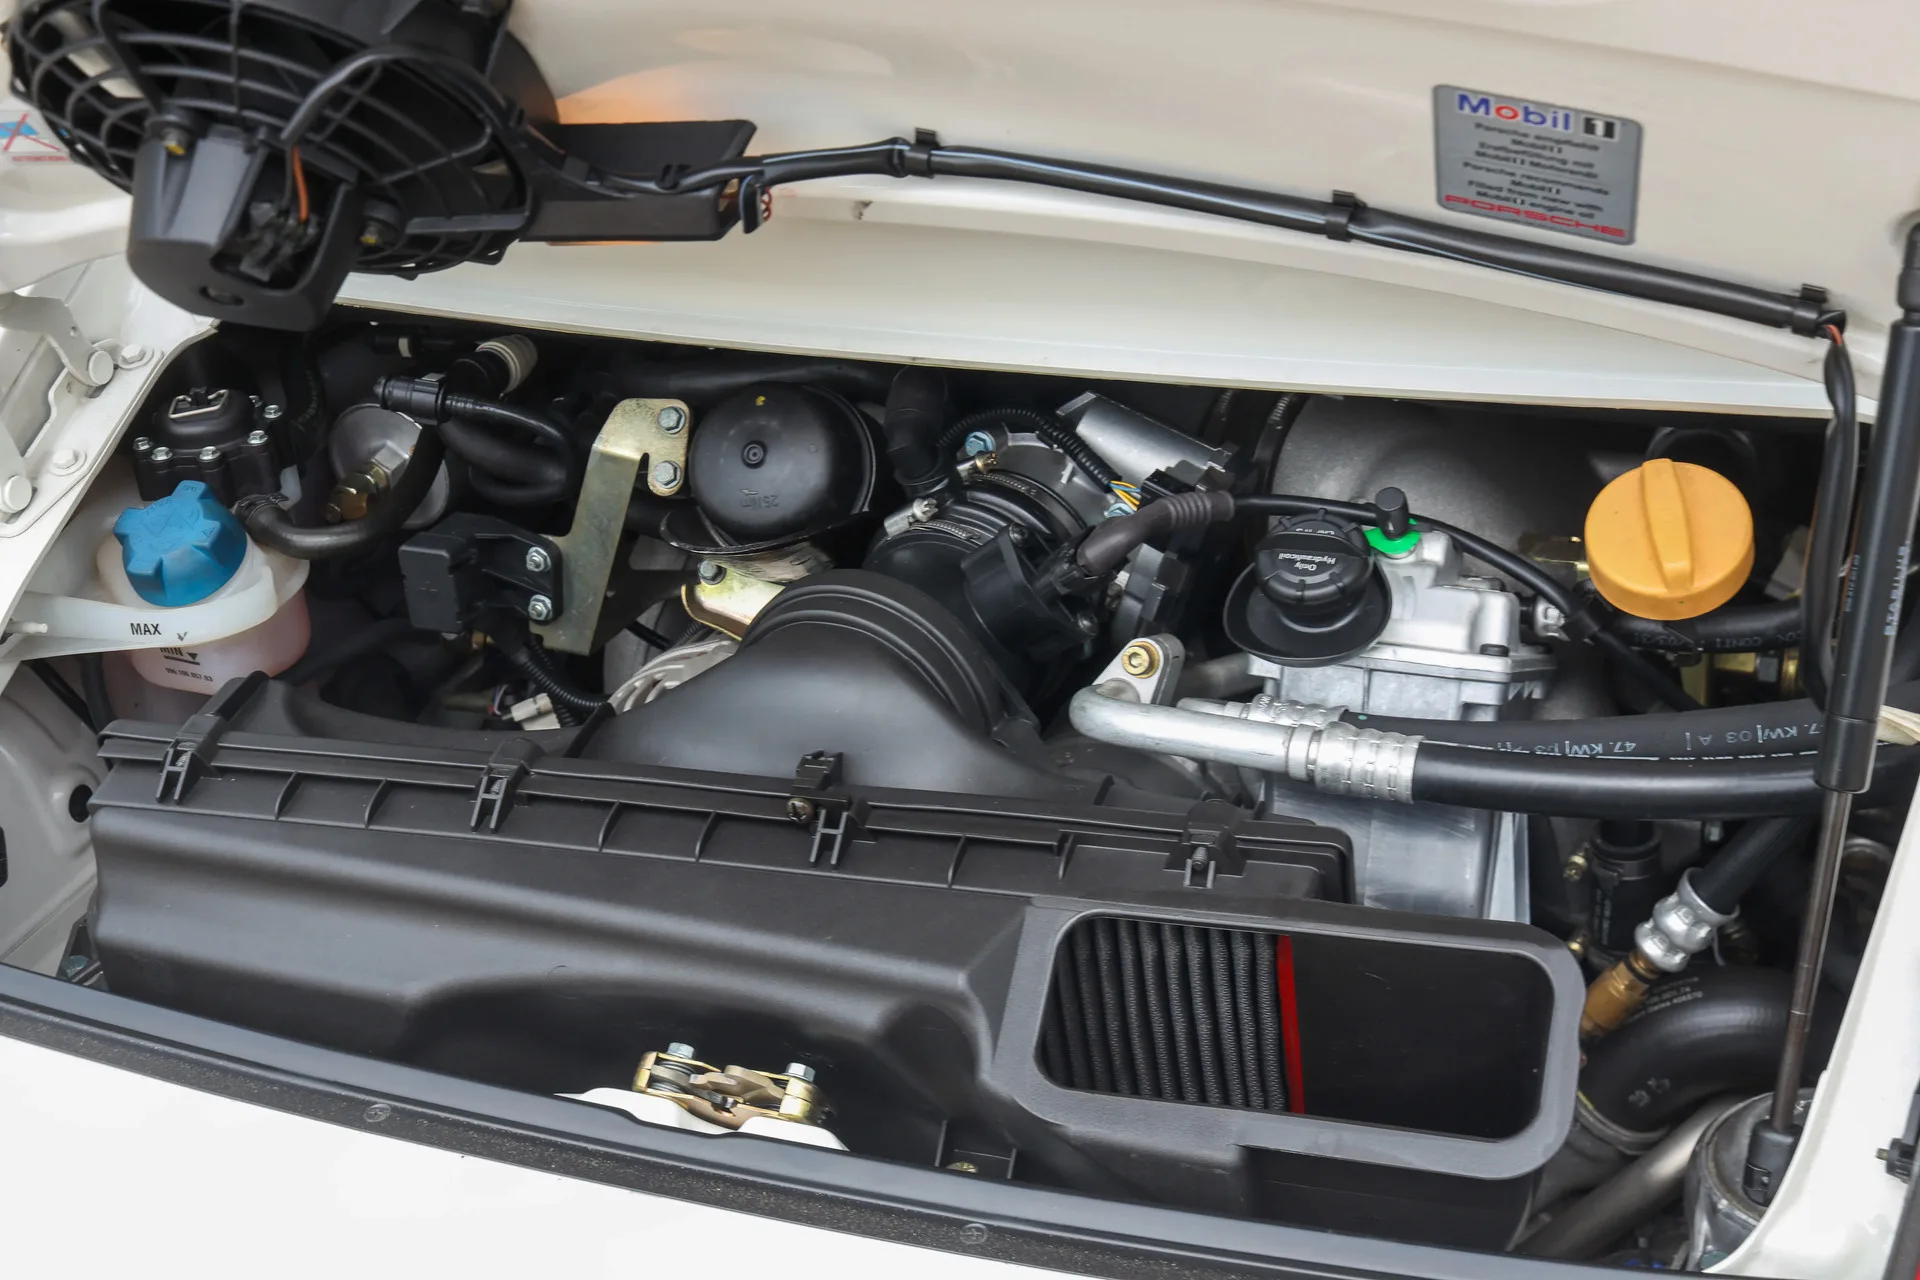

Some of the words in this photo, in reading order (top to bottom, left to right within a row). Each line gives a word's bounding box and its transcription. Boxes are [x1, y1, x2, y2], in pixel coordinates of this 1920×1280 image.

[1458, 93, 1571, 130] Mobil
[1584, 117, 1615, 138] 1
[1444, 194, 1626, 237] PORSCHE
[1293, 561, 1318, 571] Only
[130, 622, 162, 636] MAX
